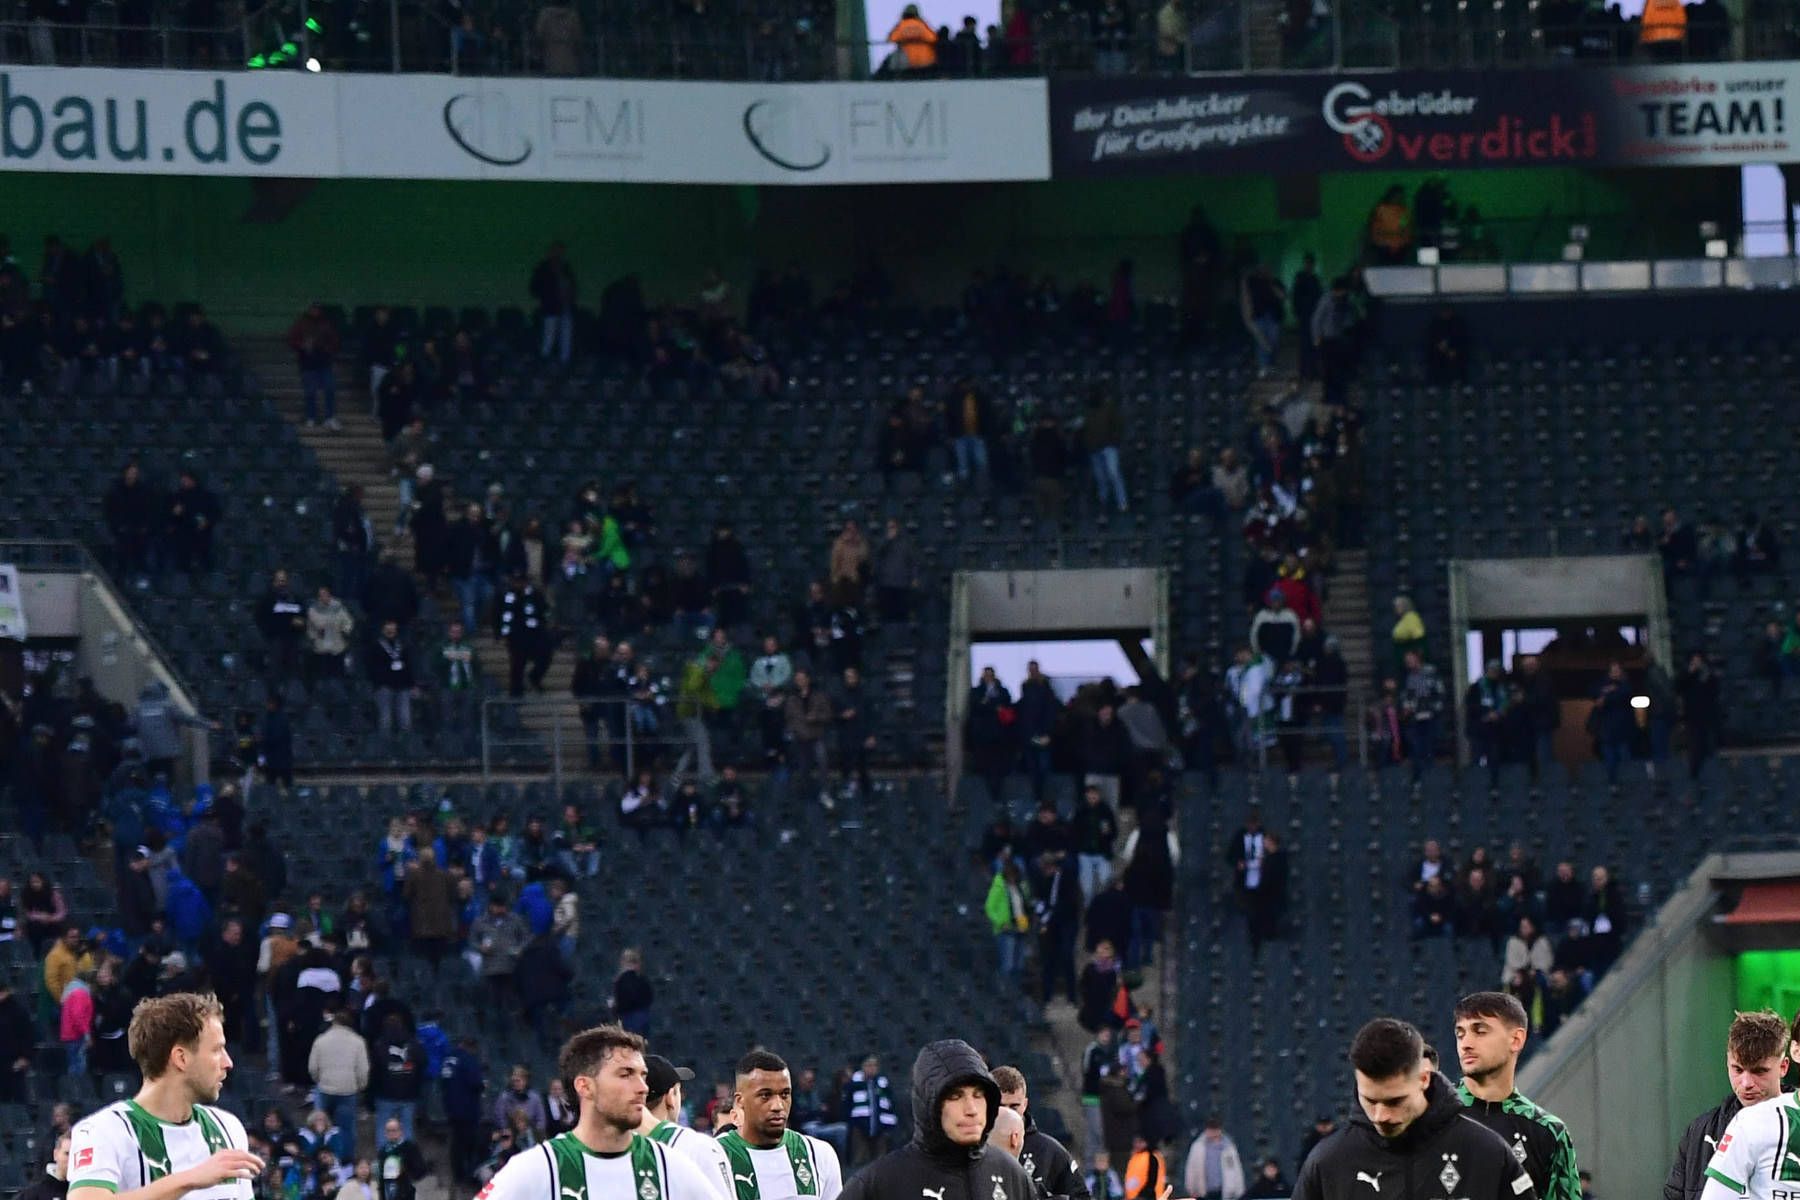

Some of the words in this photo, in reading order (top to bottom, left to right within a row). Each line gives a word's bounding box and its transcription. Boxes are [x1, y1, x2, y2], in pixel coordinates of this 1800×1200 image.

[1725, 78, 1786, 93] unser
[0, 74, 282, 165] bau.de
[549, 98, 646, 147] FMI
[849, 100, 948, 147] FMI
[1639, 97, 1785, 138] TEAM!
